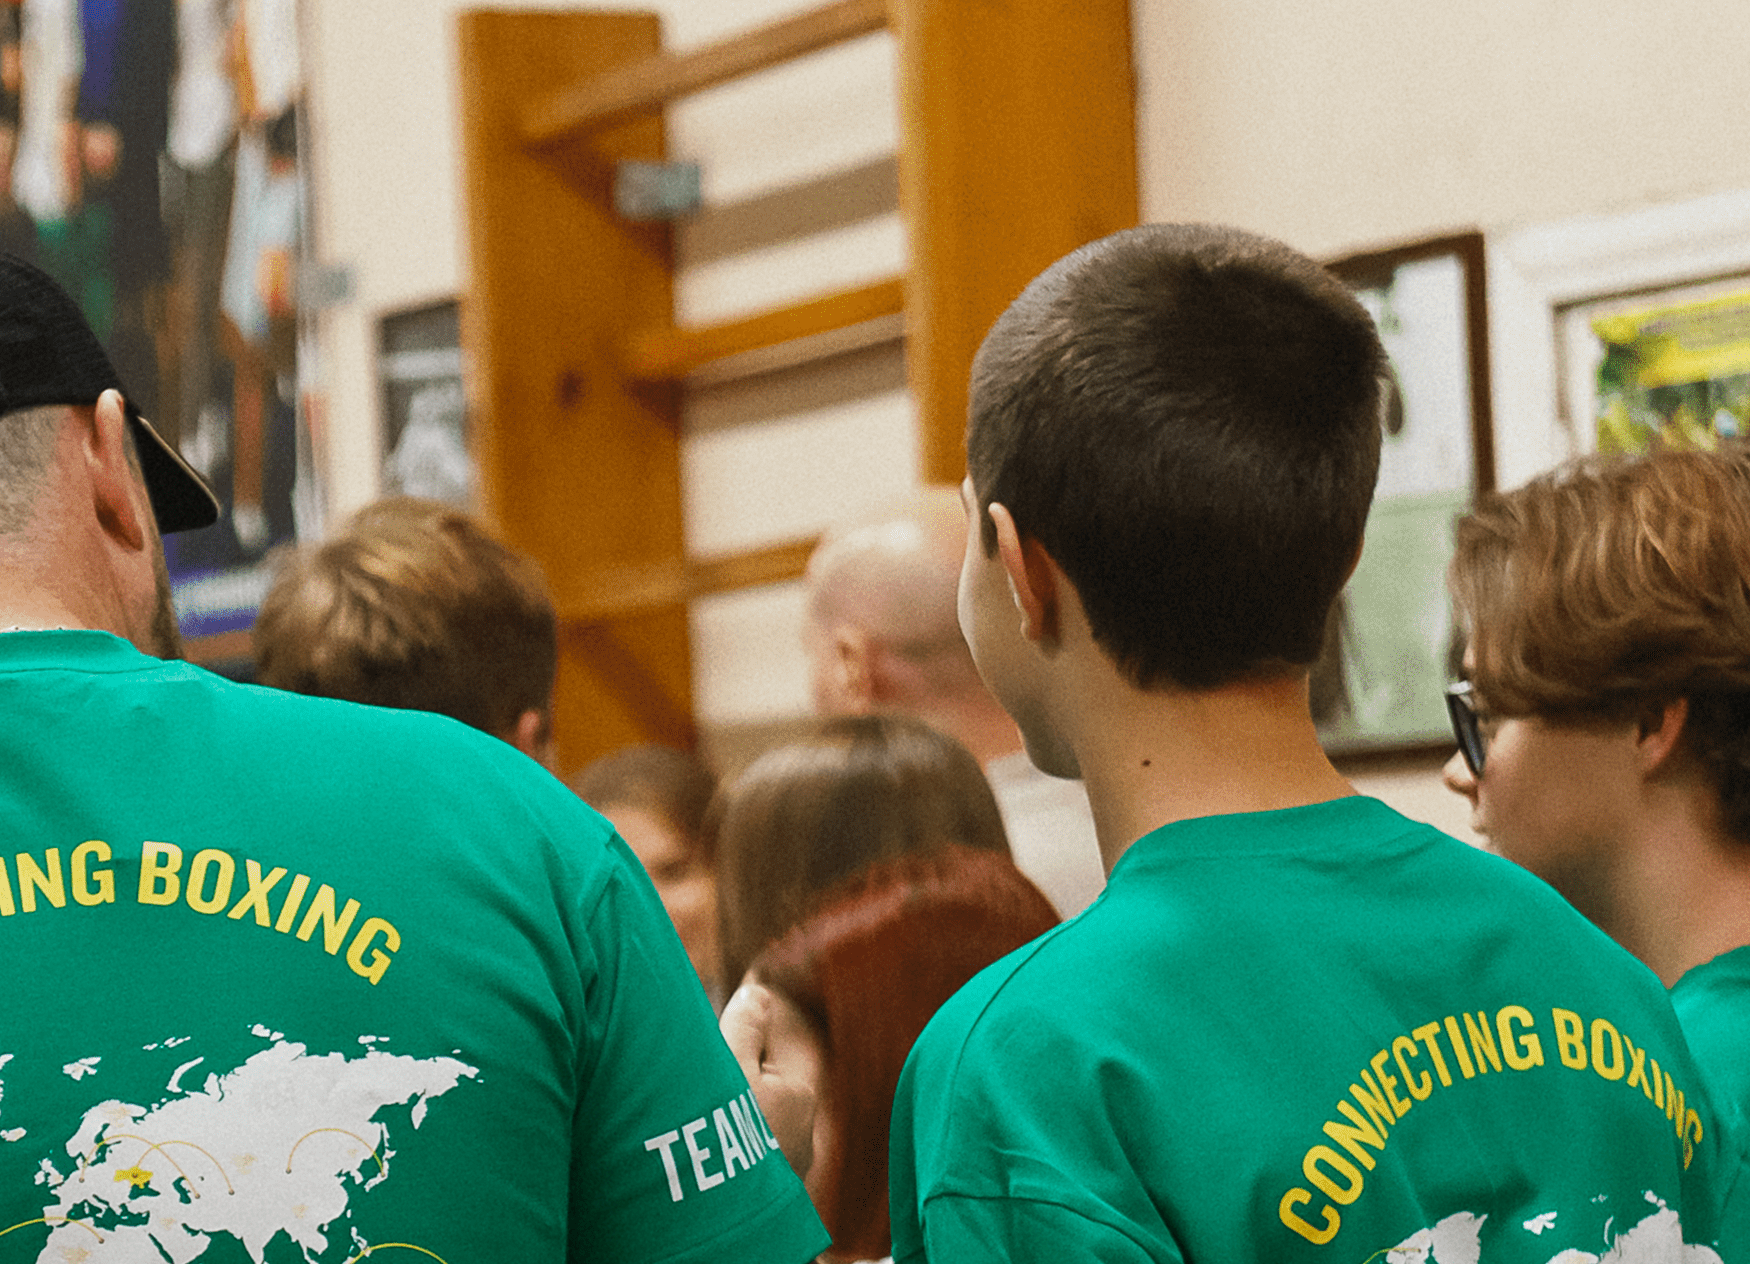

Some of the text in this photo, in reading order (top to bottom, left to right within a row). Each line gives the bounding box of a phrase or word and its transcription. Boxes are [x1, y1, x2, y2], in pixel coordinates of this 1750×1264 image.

[137, 841, 402, 985] BOXING
[644, 1093, 767, 1202] TEAM
[1279, 1005, 1703, 1245] CONNECTING BOXING
